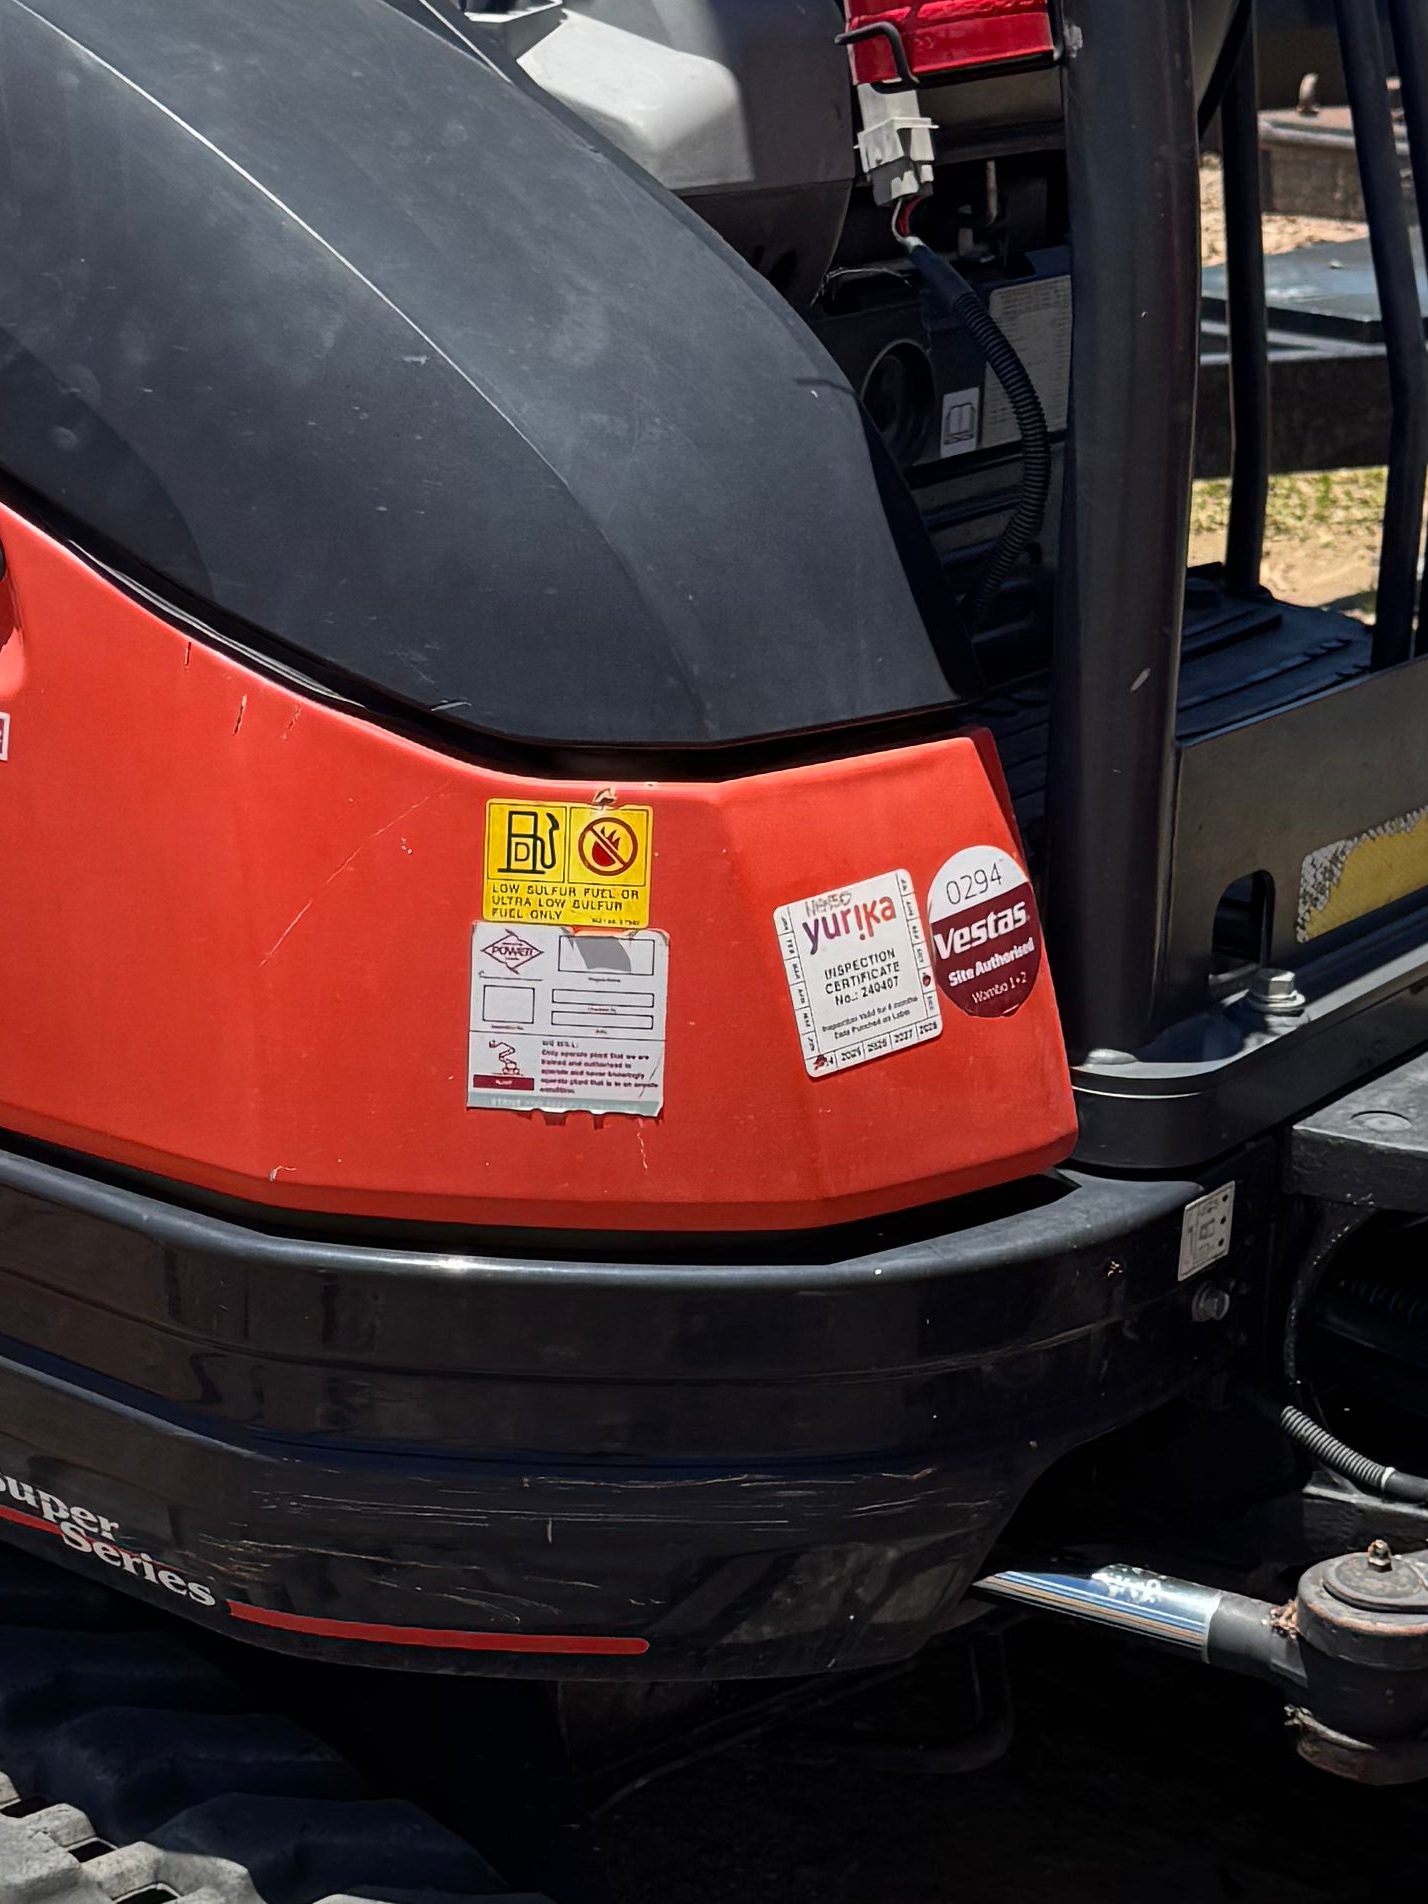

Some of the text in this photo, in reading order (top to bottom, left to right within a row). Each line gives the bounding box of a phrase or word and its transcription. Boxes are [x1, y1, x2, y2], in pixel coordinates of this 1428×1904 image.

[493, 883, 640, 900] LOW SULFUR FUEL OR
[946, 862, 1002, 905] 0294
[492, 895, 622, 911] ULTRA LOW SULFUR
[492, 908, 563, 920] FUEL ONLY
[933, 901, 1027, 960] Vestas
[824, 948, 896, 980] INSPECTION
[825, 961, 900, 994] CERTIFICATE
[948, 968, 975, 987] Site
[975, 937, 1035, 976] Authorised
[861, 976, 899, 998] 240407
[59, 1520, 217, 1608] Series
